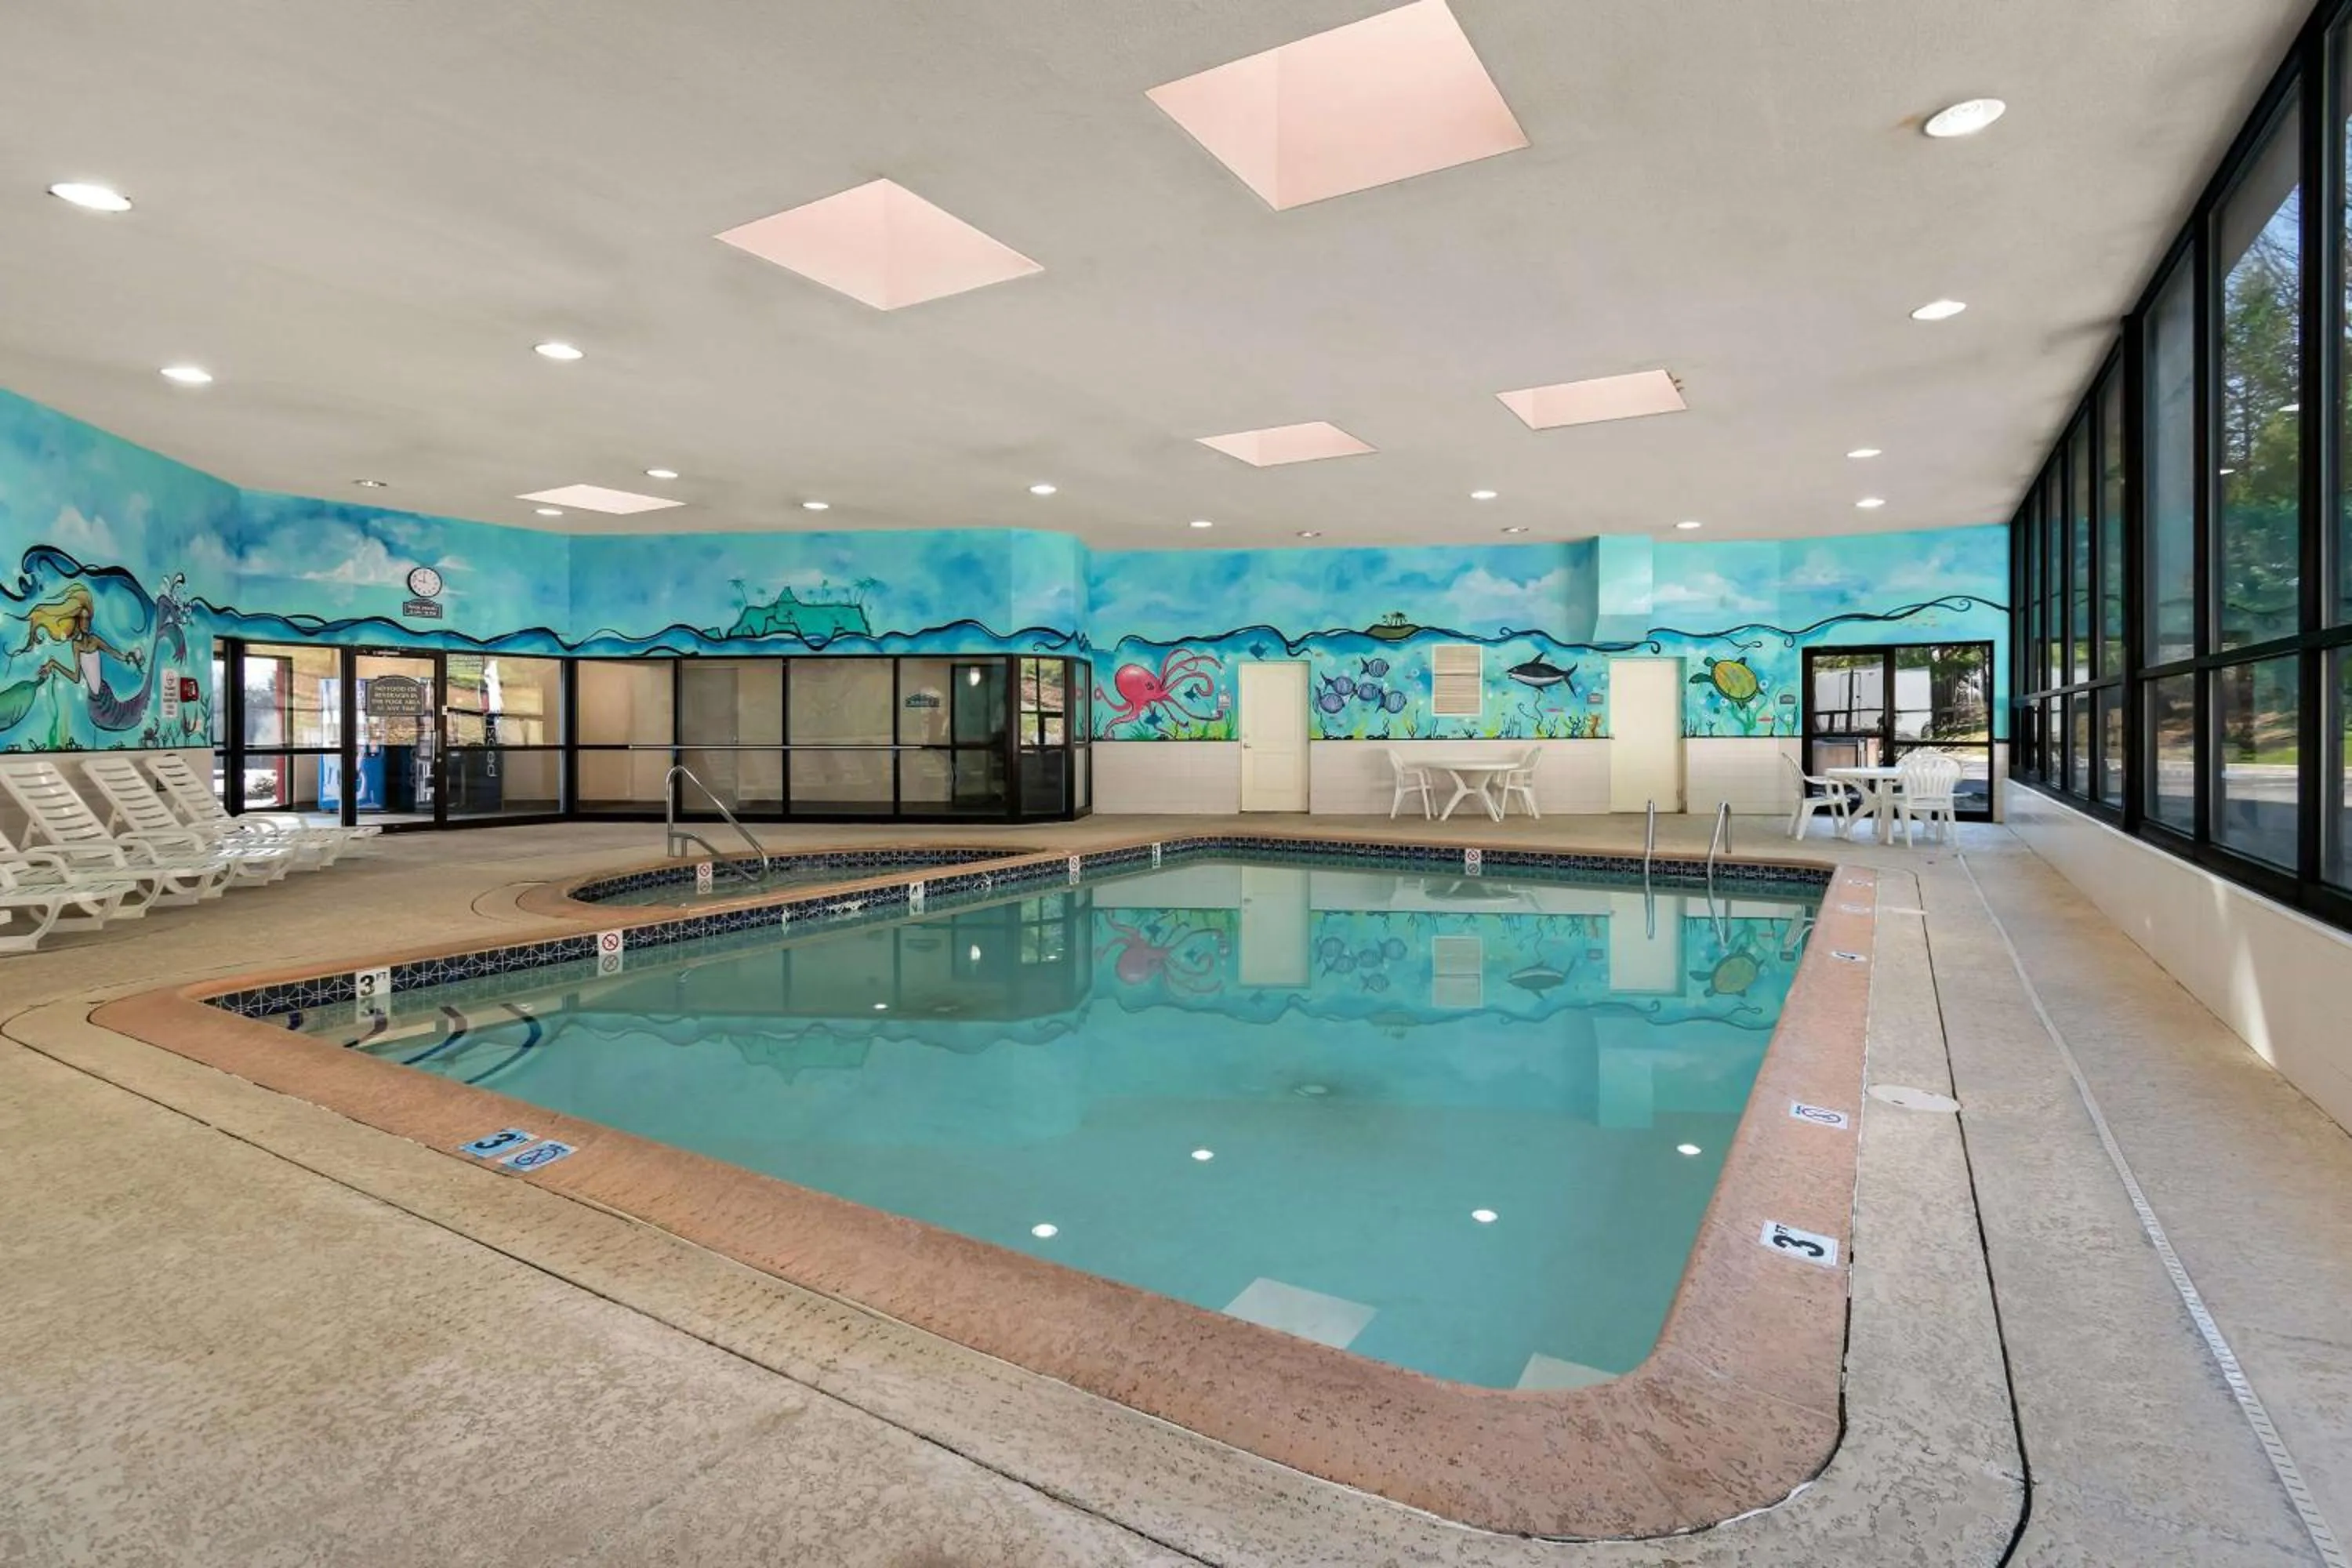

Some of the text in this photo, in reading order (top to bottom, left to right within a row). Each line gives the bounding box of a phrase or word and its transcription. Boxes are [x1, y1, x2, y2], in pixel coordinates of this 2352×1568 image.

[360, 975, 376, 996] 3
[474, 1133, 517, 1149] 3
[1773, 1235, 1824, 1257] 3
